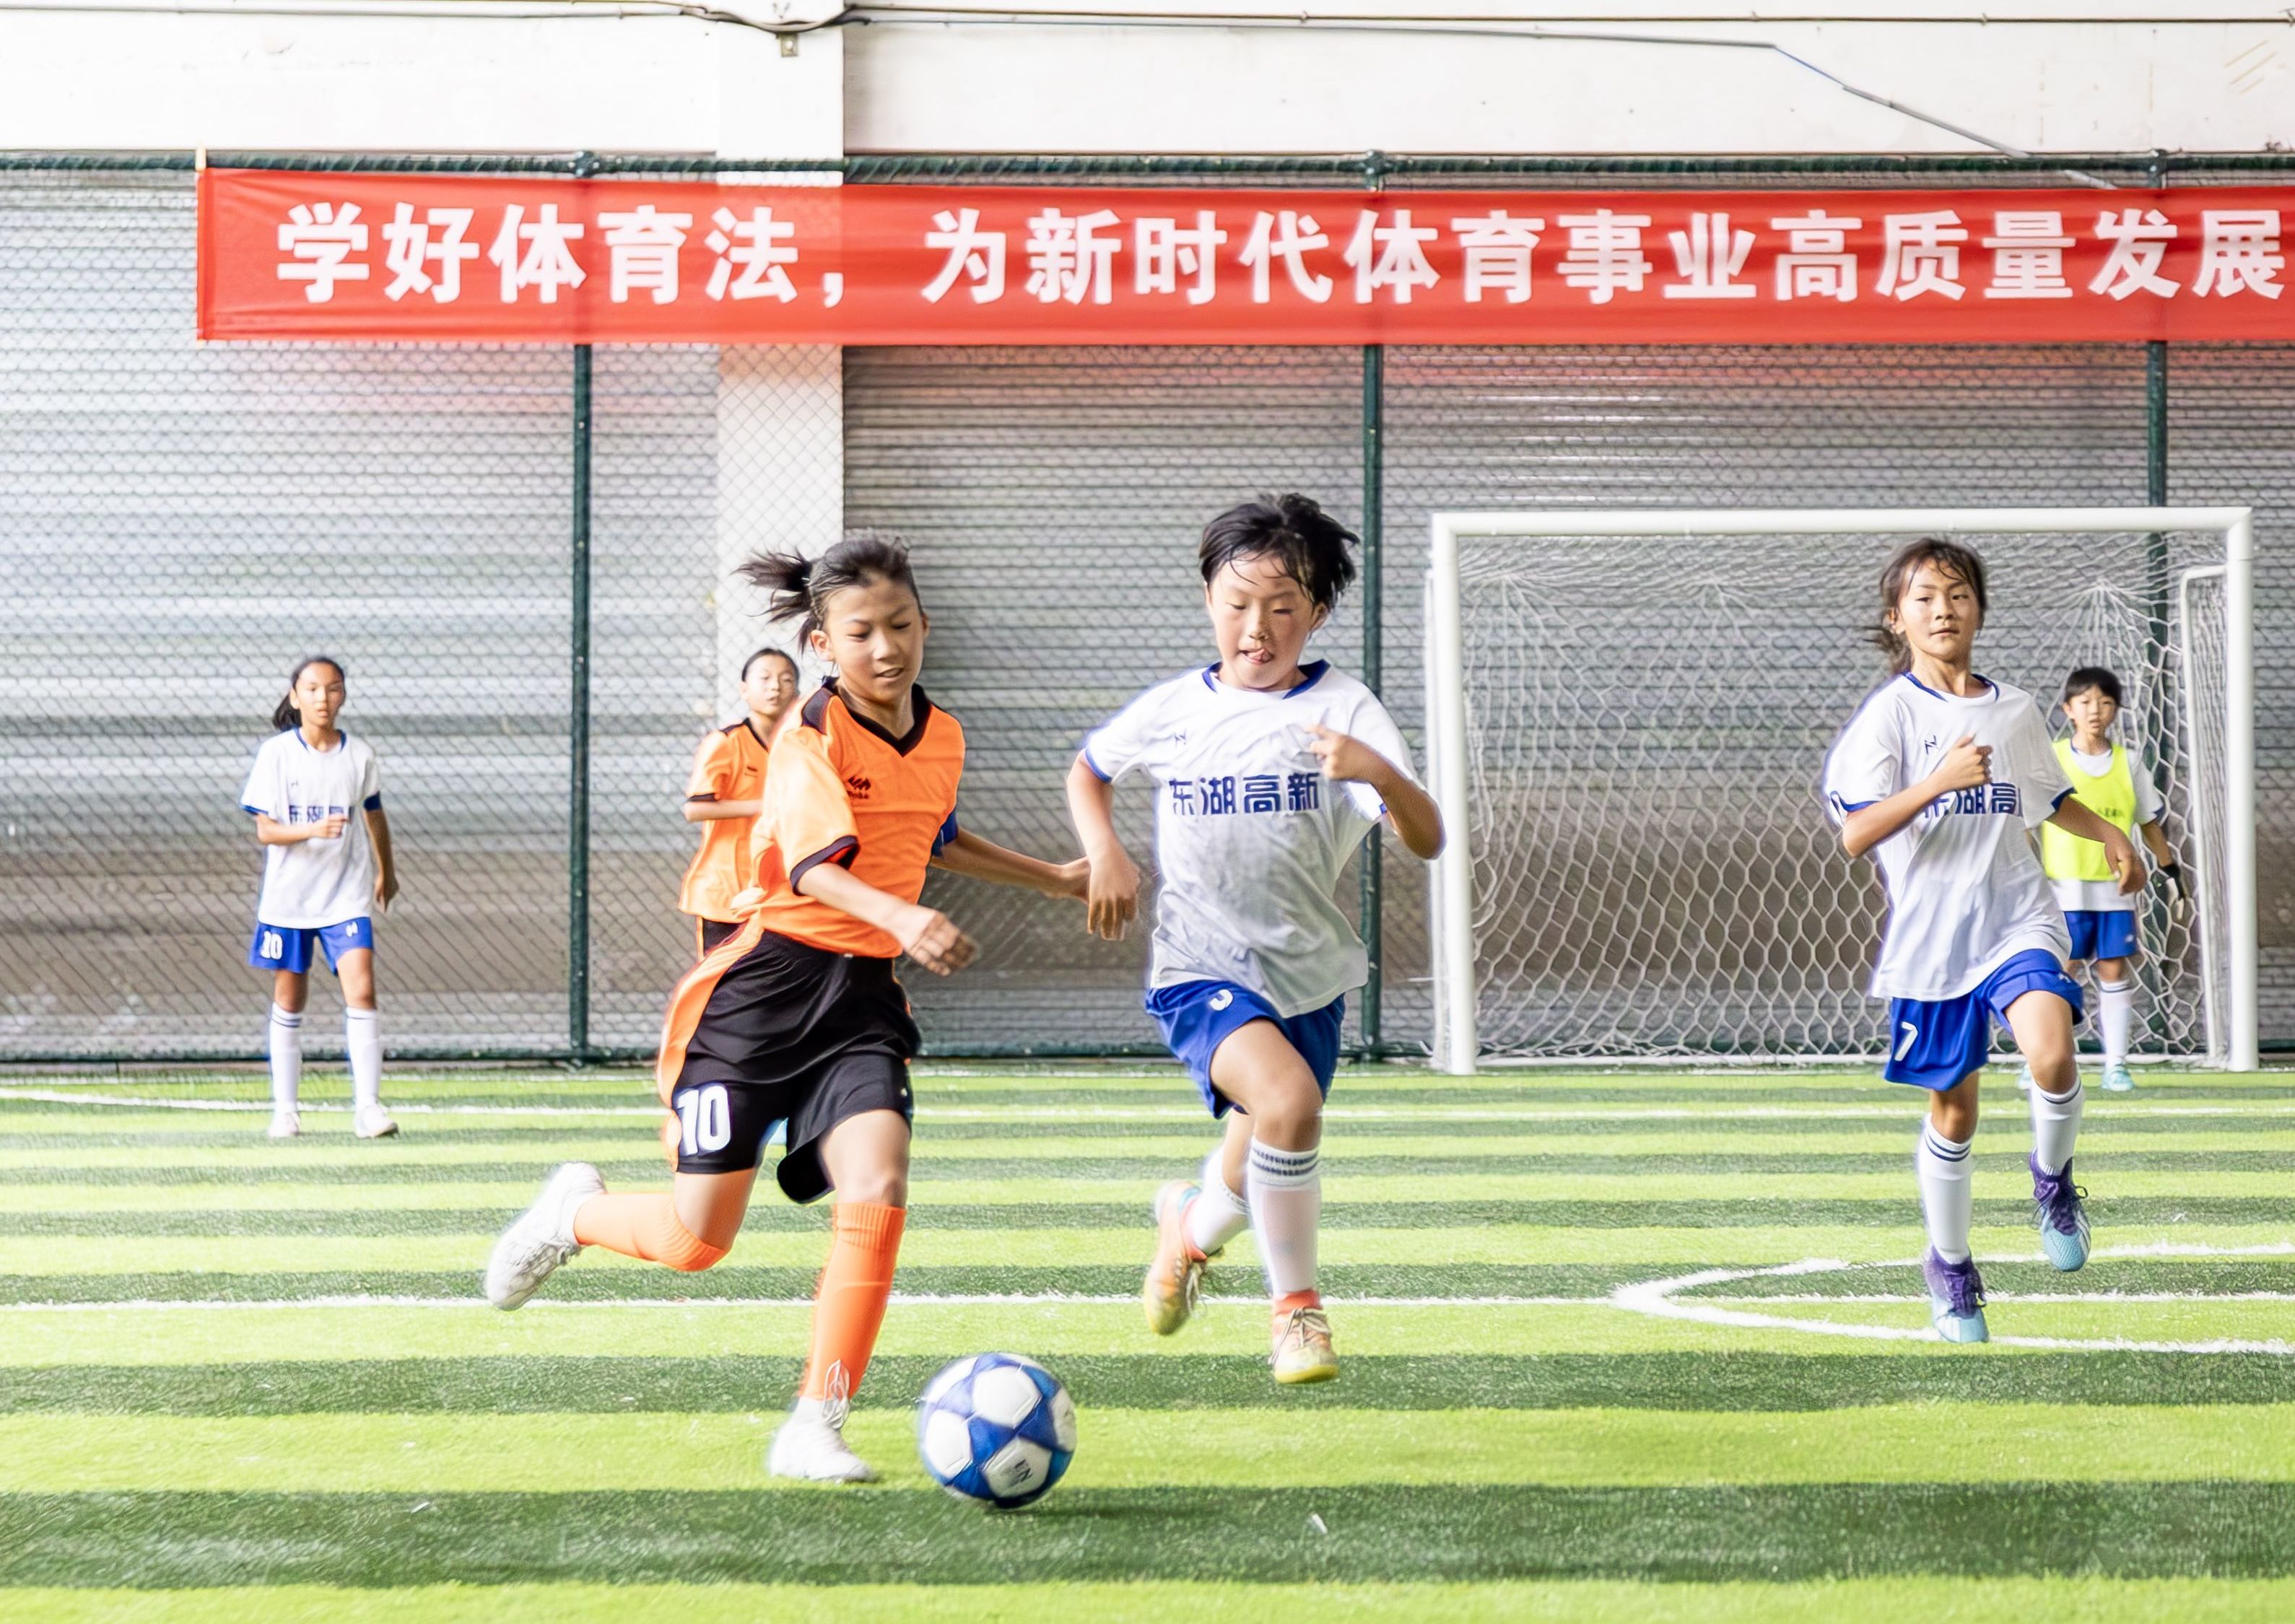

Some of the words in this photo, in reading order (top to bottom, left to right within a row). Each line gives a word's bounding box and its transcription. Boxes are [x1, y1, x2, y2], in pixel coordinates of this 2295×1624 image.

[277, 202, 2285, 306] 学好体育法，为新时代体育事业高质量发展
[1169, 772, 1320, 816] 东湖高新
[1922, 782, 2024, 818] 湖高
[260, 930, 283, 960] 10
[1894, 1021, 1918, 1062] 7
[676, 1085, 731, 1156] 10
